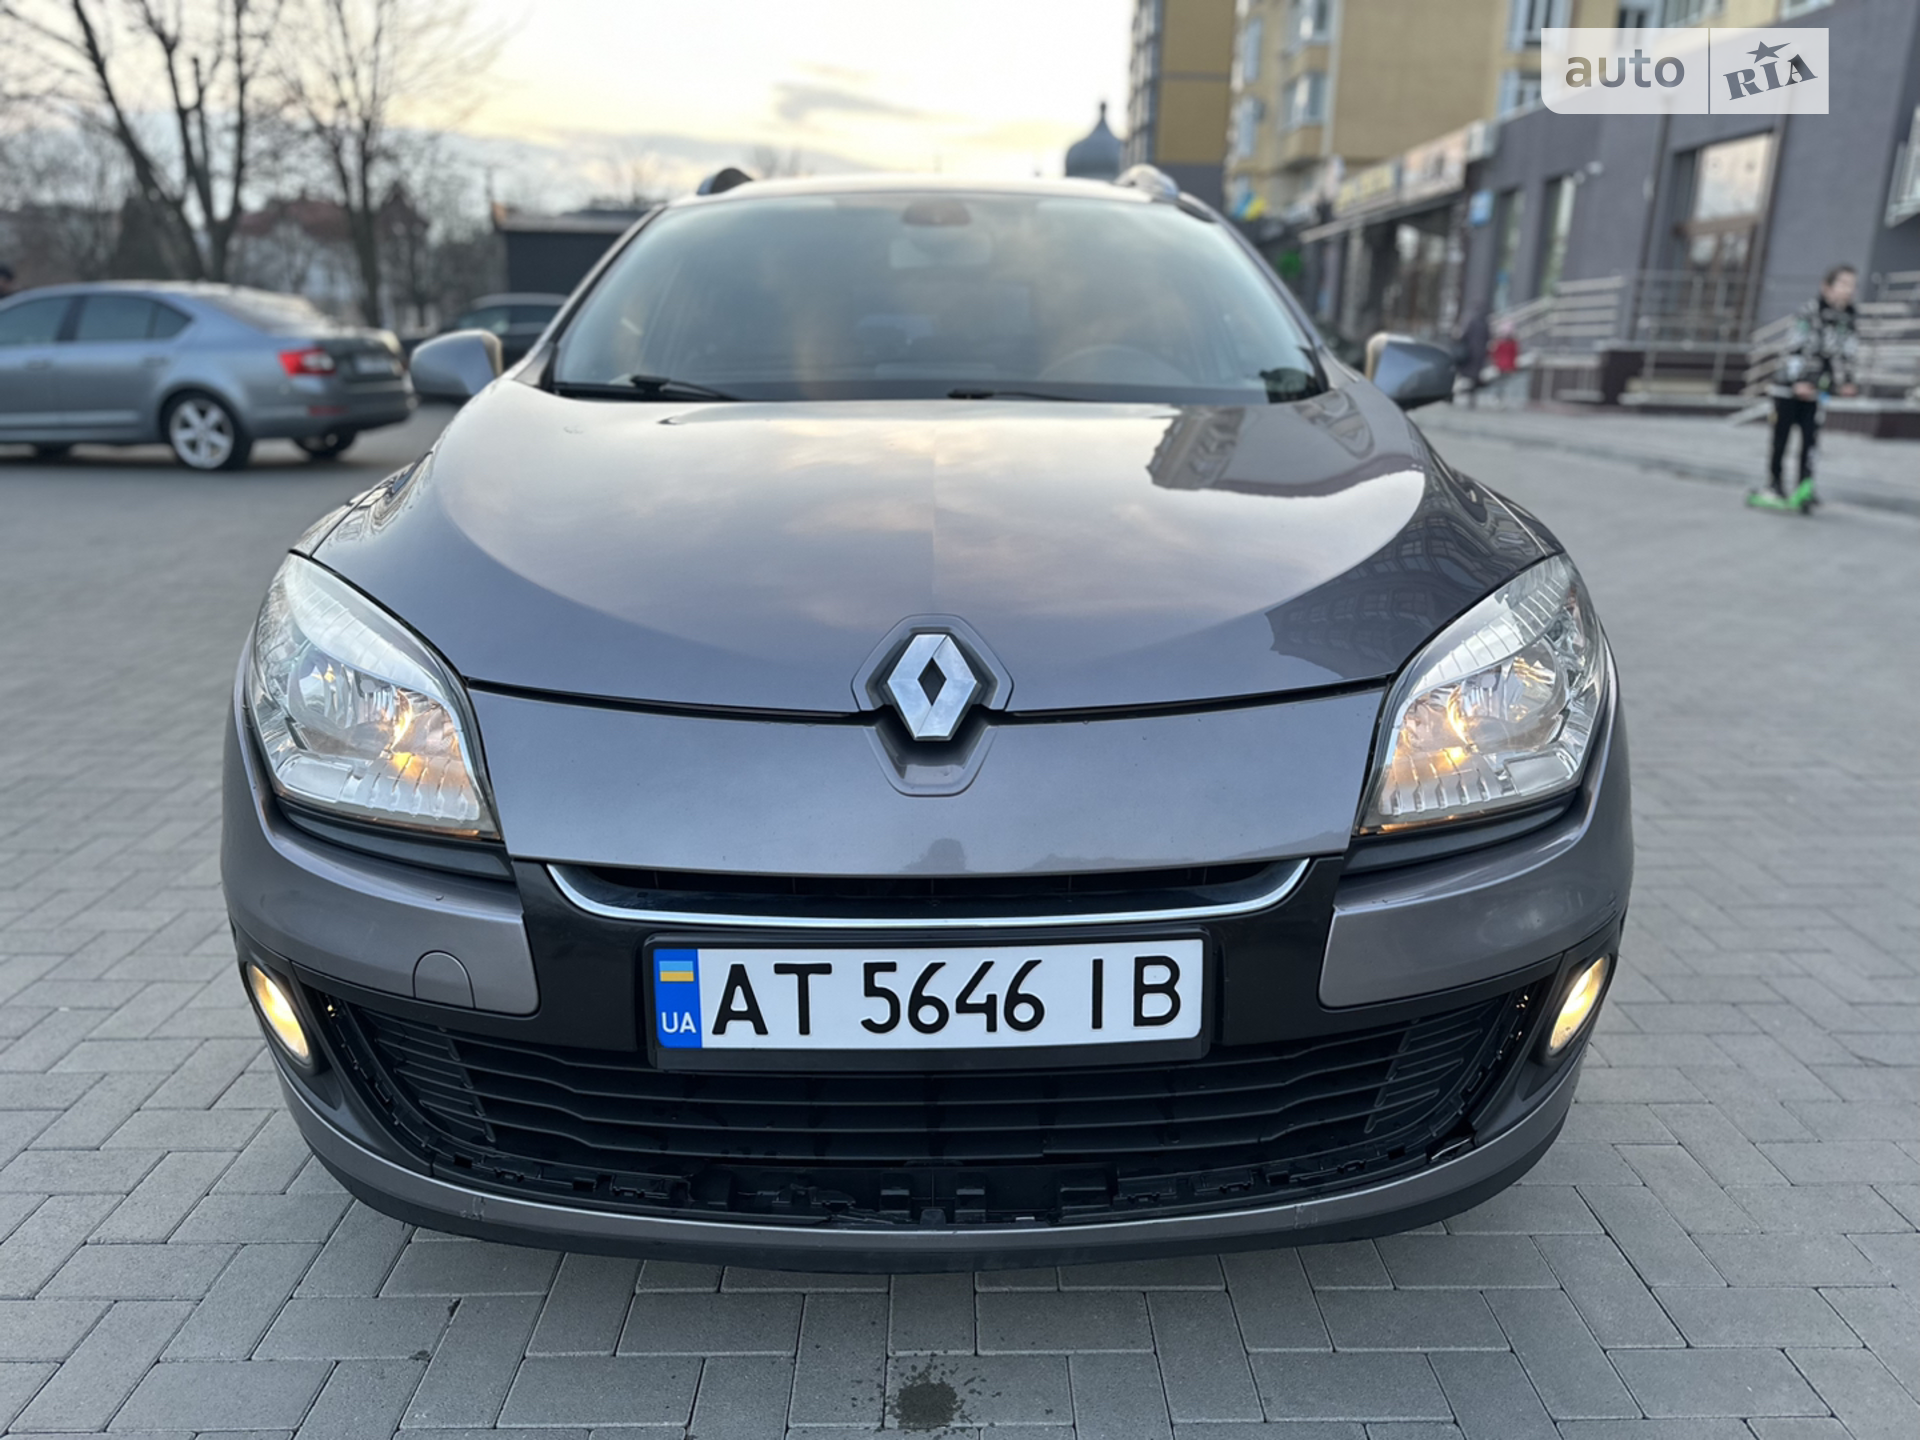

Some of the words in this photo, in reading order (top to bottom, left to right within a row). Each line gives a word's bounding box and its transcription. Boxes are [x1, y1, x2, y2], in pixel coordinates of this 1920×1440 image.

[711, 962, 833, 1036] AT
[860, 958, 1045, 1035] 5646
[1091, 954, 1182, 1030] IB
[661, 1011, 697, 1034] UA
